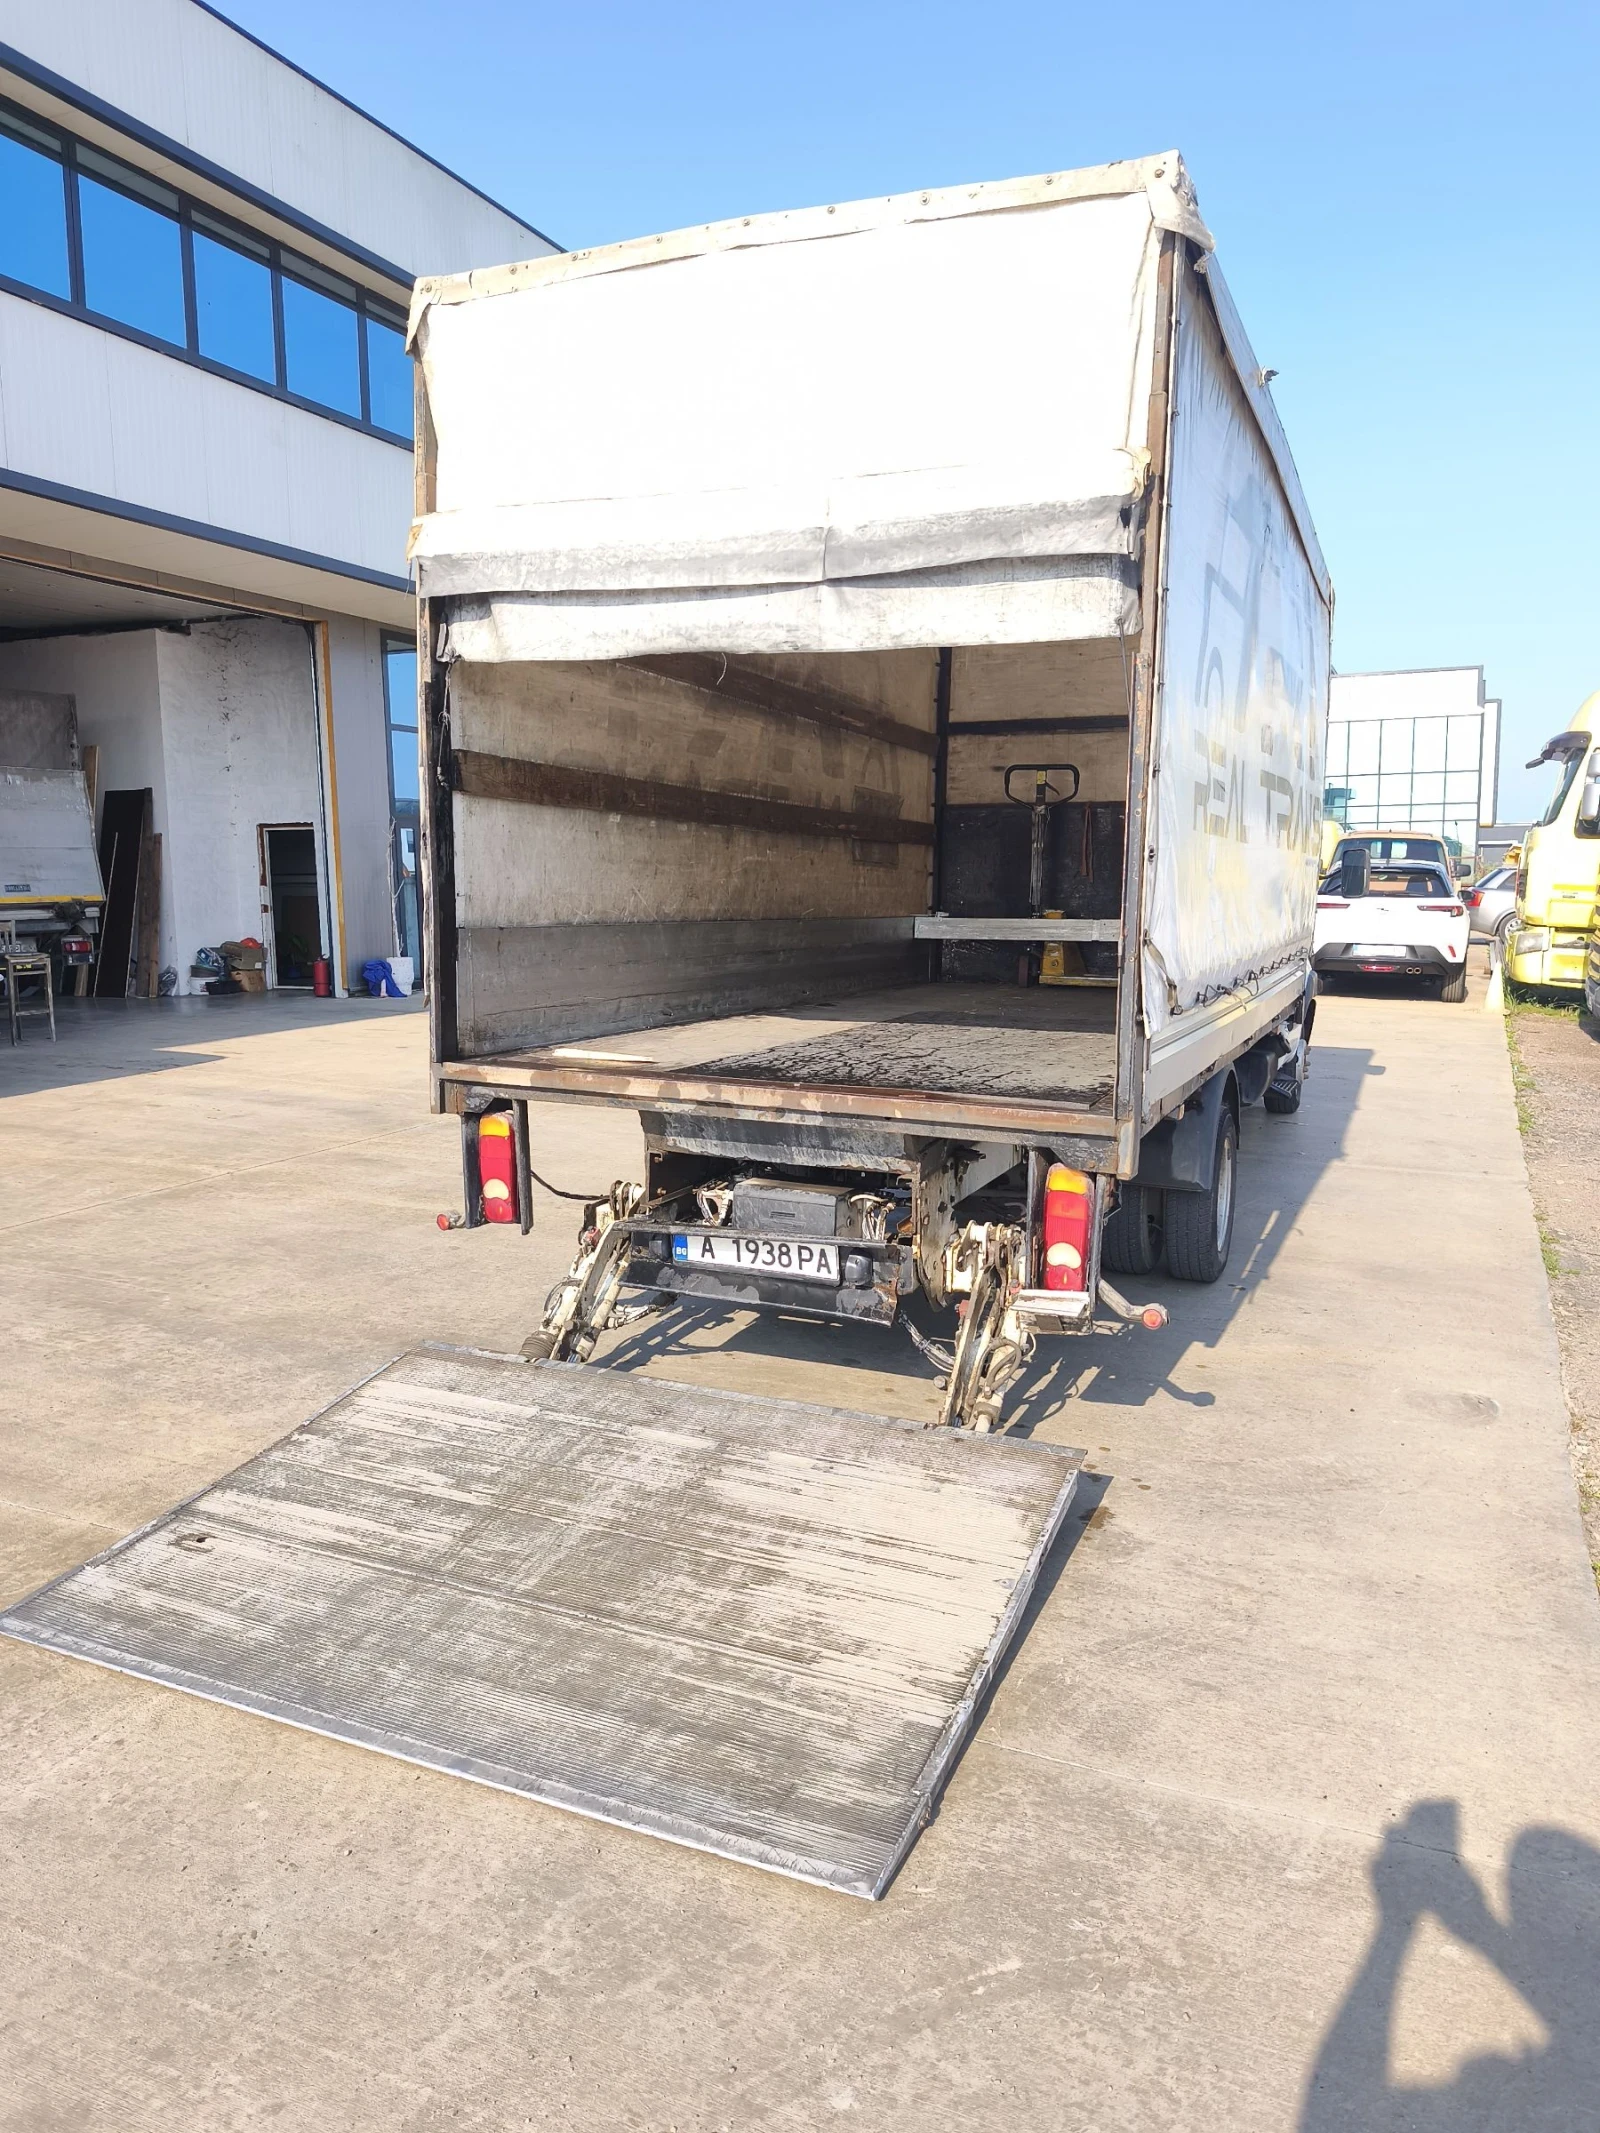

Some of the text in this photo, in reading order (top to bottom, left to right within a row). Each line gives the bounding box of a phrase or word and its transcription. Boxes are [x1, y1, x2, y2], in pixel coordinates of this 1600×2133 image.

[1193, 728, 1248, 844] REAL
[675, 1246, 687, 1256] BG
[701, 1236, 832, 1275] A 1938 PA
